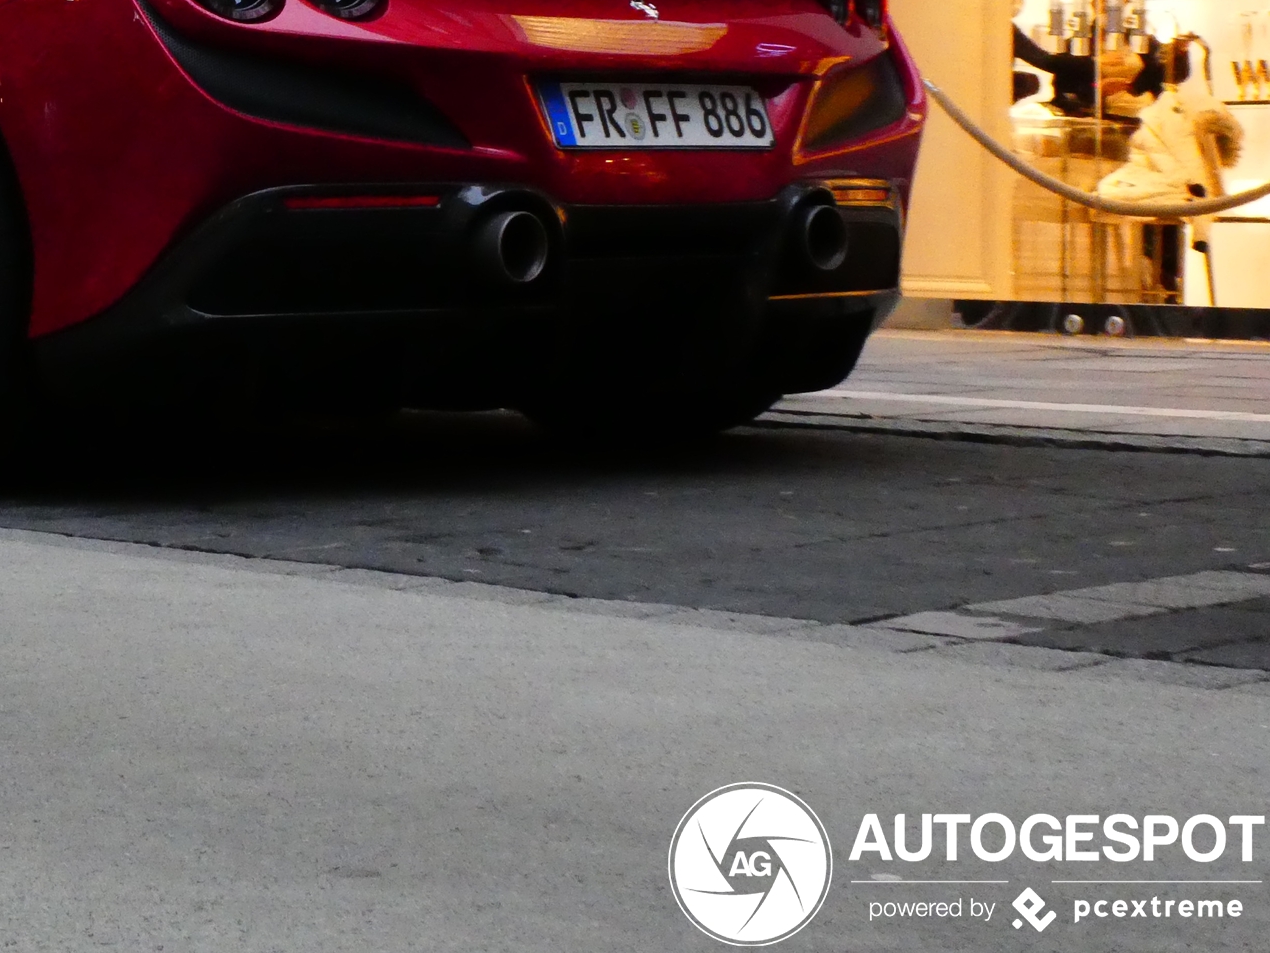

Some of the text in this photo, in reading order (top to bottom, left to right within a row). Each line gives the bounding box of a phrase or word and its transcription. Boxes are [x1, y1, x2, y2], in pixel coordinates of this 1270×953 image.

[568, 89, 767, 138] FR FF 886
